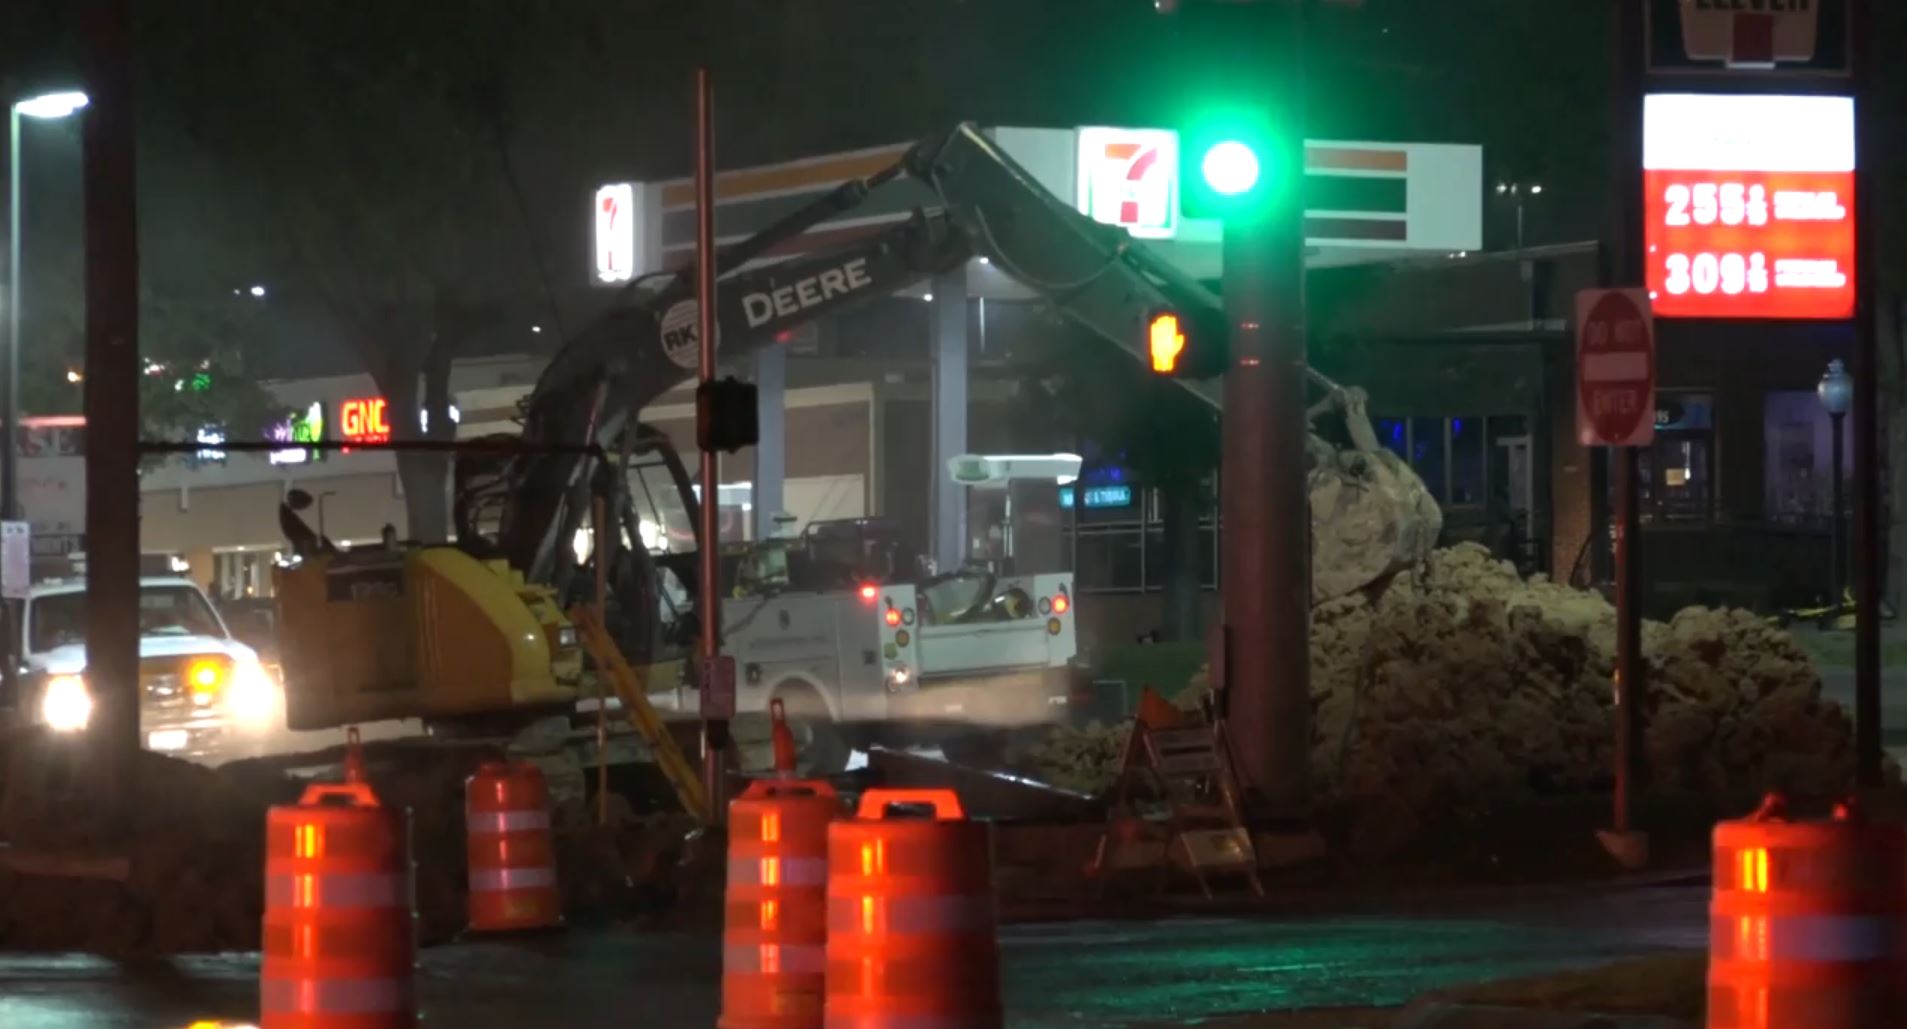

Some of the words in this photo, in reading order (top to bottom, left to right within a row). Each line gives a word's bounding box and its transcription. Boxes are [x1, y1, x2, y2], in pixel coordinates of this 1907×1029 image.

[741, 257, 873, 329] DEERE
[1587, 320, 1609, 346] DO
[341, 399, 390, 437] GNC
[1593, 388, 1638, 417] ENTER
